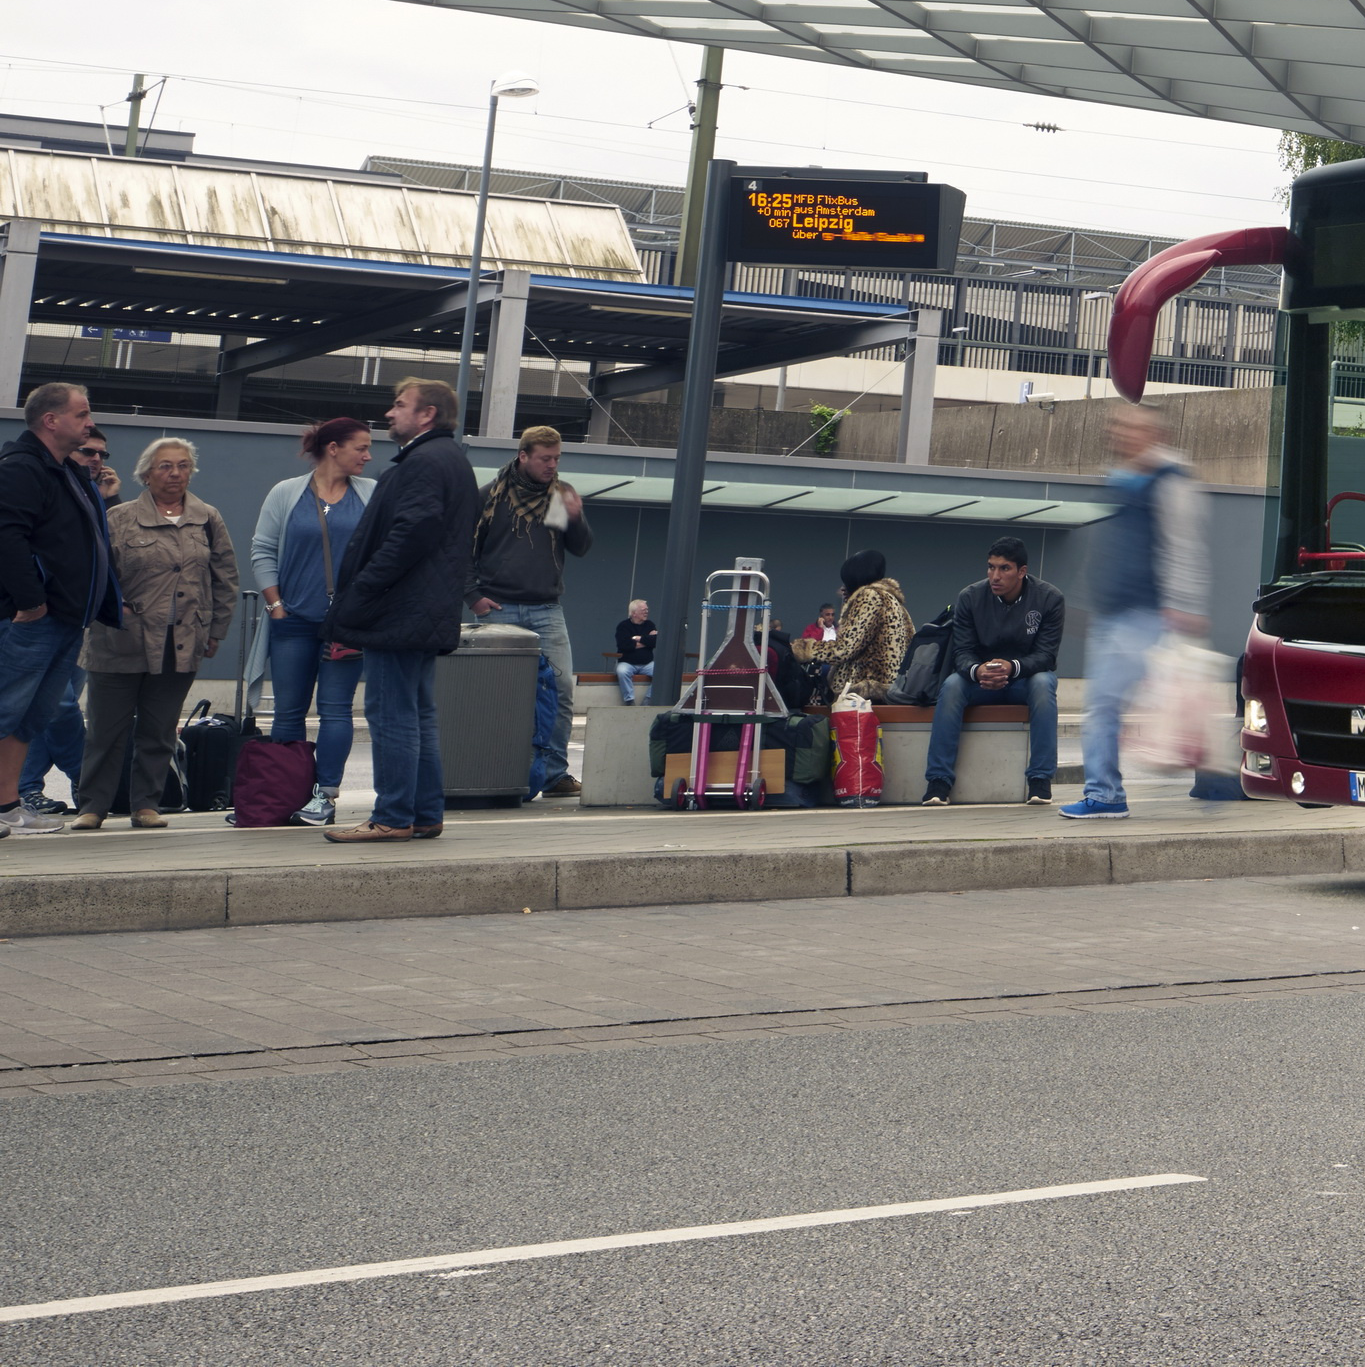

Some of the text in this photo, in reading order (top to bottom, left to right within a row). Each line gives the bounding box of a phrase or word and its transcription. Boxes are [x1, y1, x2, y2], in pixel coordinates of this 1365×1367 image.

[748, 180, 758, 191] 4
[748, 193, 859, 208] 16:25 MFB FlixBus
[774, 208, 791, 217] min
[793, 206, 814, 214] aus
[815, 205, 876, 216] Amsterdam
[769, 213, 853, 233] 067 Leipzig
[792, 230, 819, 239] über
